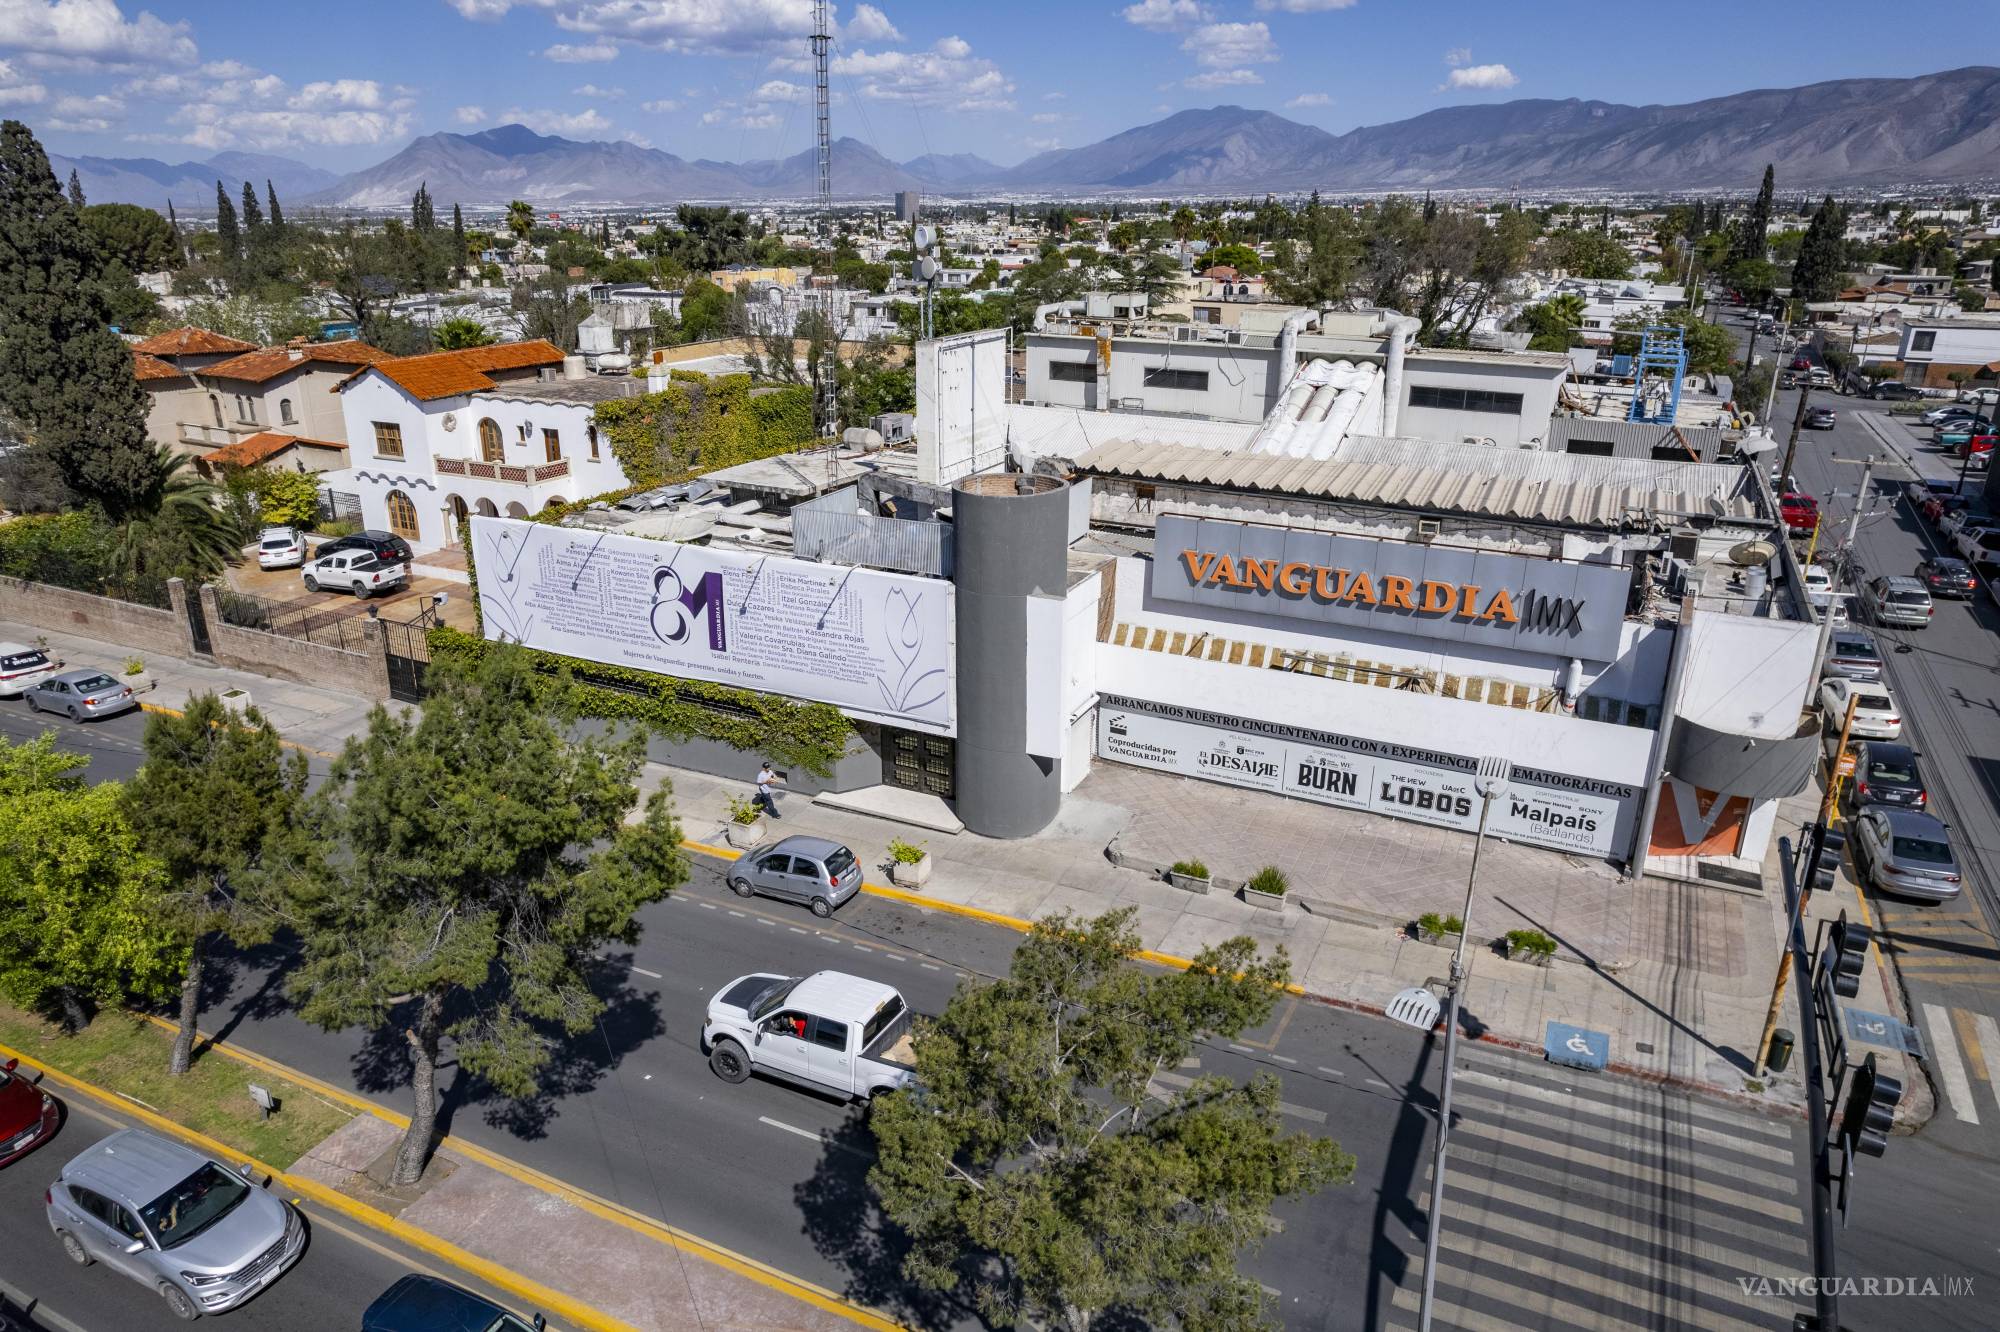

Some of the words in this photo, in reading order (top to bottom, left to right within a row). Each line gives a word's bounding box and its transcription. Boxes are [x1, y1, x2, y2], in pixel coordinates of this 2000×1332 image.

[780, 575, 796, 583] Erika
[1182, 549, 1520, 624] VANGUARDIA
[764, 636, 806, 648] Covarrubias
[805, 629, 842, 640] Kassandra
[844, 634, 865, 644] Rojas
[797, 647, 817, 657] Diana
[819, 651, 847, 662] Galindo
[1106, 695, 1184, 718] ARRANCAMOS
[1186, 709, 1239, 727] NUESTRO
[1241, 719, 1349, 747] CINCUENTENARIO
[1351, 739, 1379, 753] CON
[1380, 743, 1389, 754] 4
[1391, 746, 1479, 771] EXPERIENCIA
[1108, 736, 1161, 753] Coproducidas
[1162, 747, 1177, 757] por
[1108, 745, 1168, 764] VANGUARDIA
[1298, 763, 1359, 797] BURN
[1391, 774, 1406, 783] THE
[1380, 781, 1473, 817] LOBOS
[1510, 801, 1597, 832] Malpaís
[1578, 806, 1604, 815] SONY
[1530, 822, 1595, 845] (Badlands)
